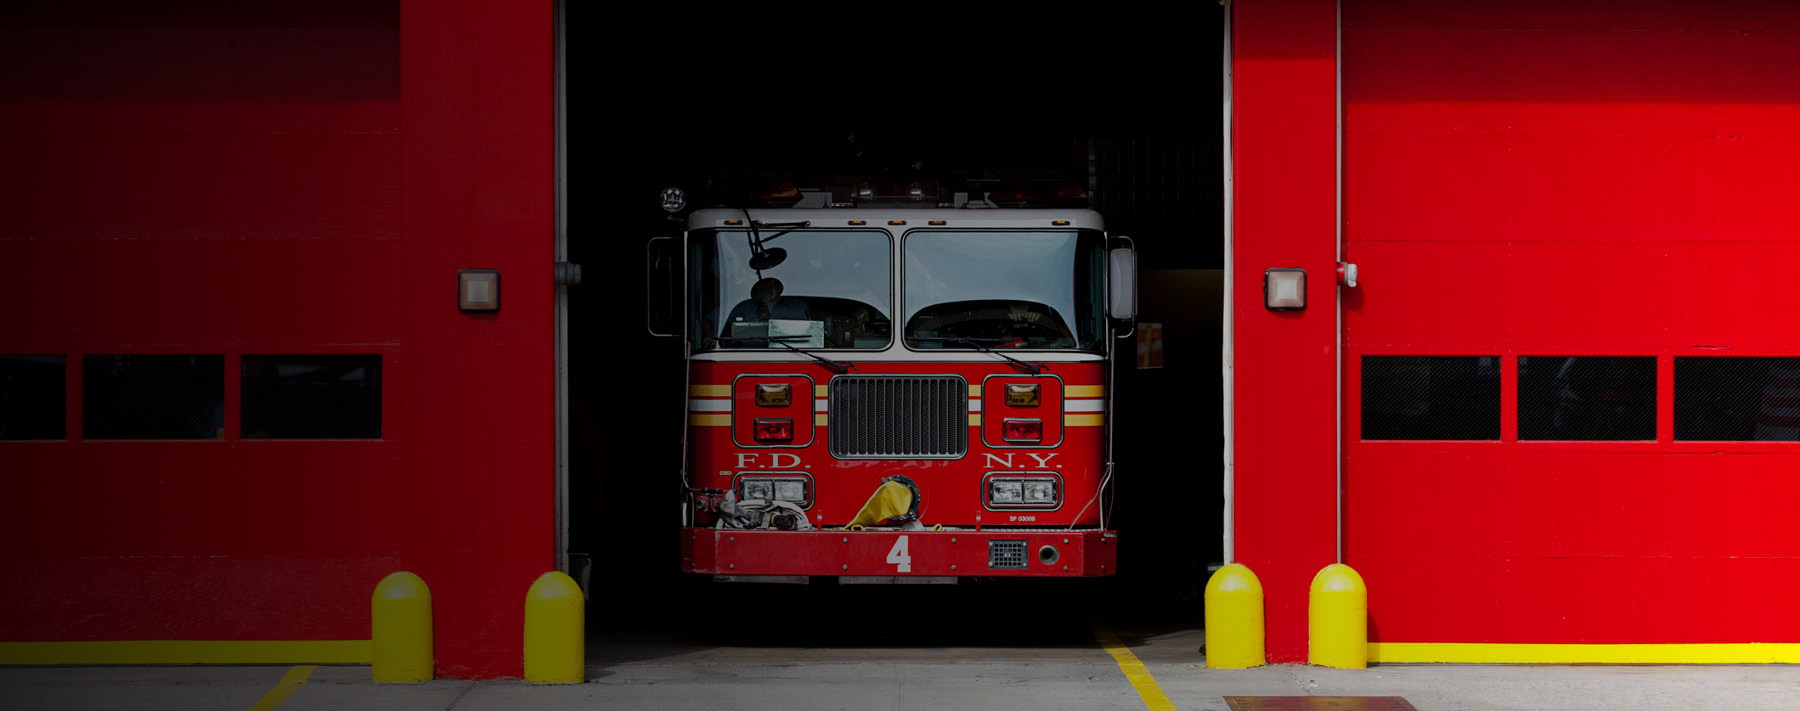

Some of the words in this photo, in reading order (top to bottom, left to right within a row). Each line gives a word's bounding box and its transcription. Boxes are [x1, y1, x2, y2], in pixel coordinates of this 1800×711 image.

[734, 453, 813, 469] F.D.
[980, 453, 1063, 469] N.Y.
[886, 534, 912, 573] 4
